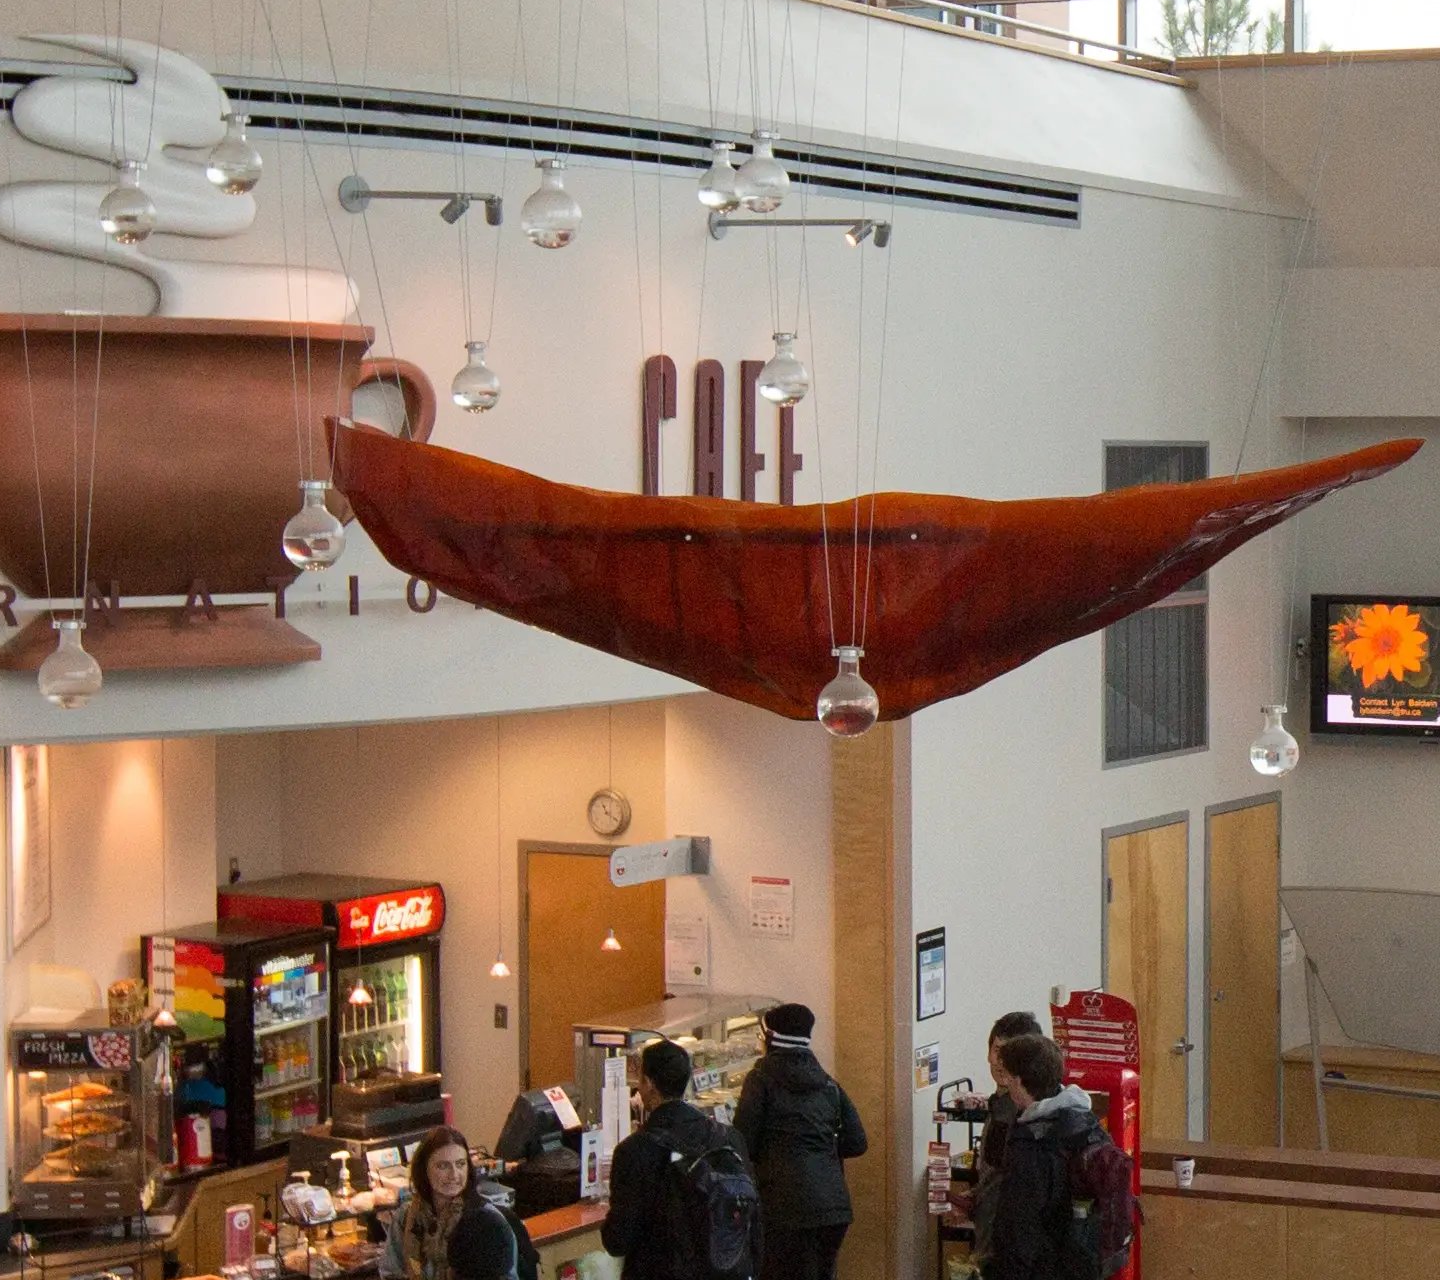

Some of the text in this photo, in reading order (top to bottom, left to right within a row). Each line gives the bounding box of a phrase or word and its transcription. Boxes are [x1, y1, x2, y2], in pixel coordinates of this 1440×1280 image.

[1359, 697, 1389, 706] Contact
[23, 1040, 66, 1054] FRESH
[48, 1051, 89, 1066] PIZZA
